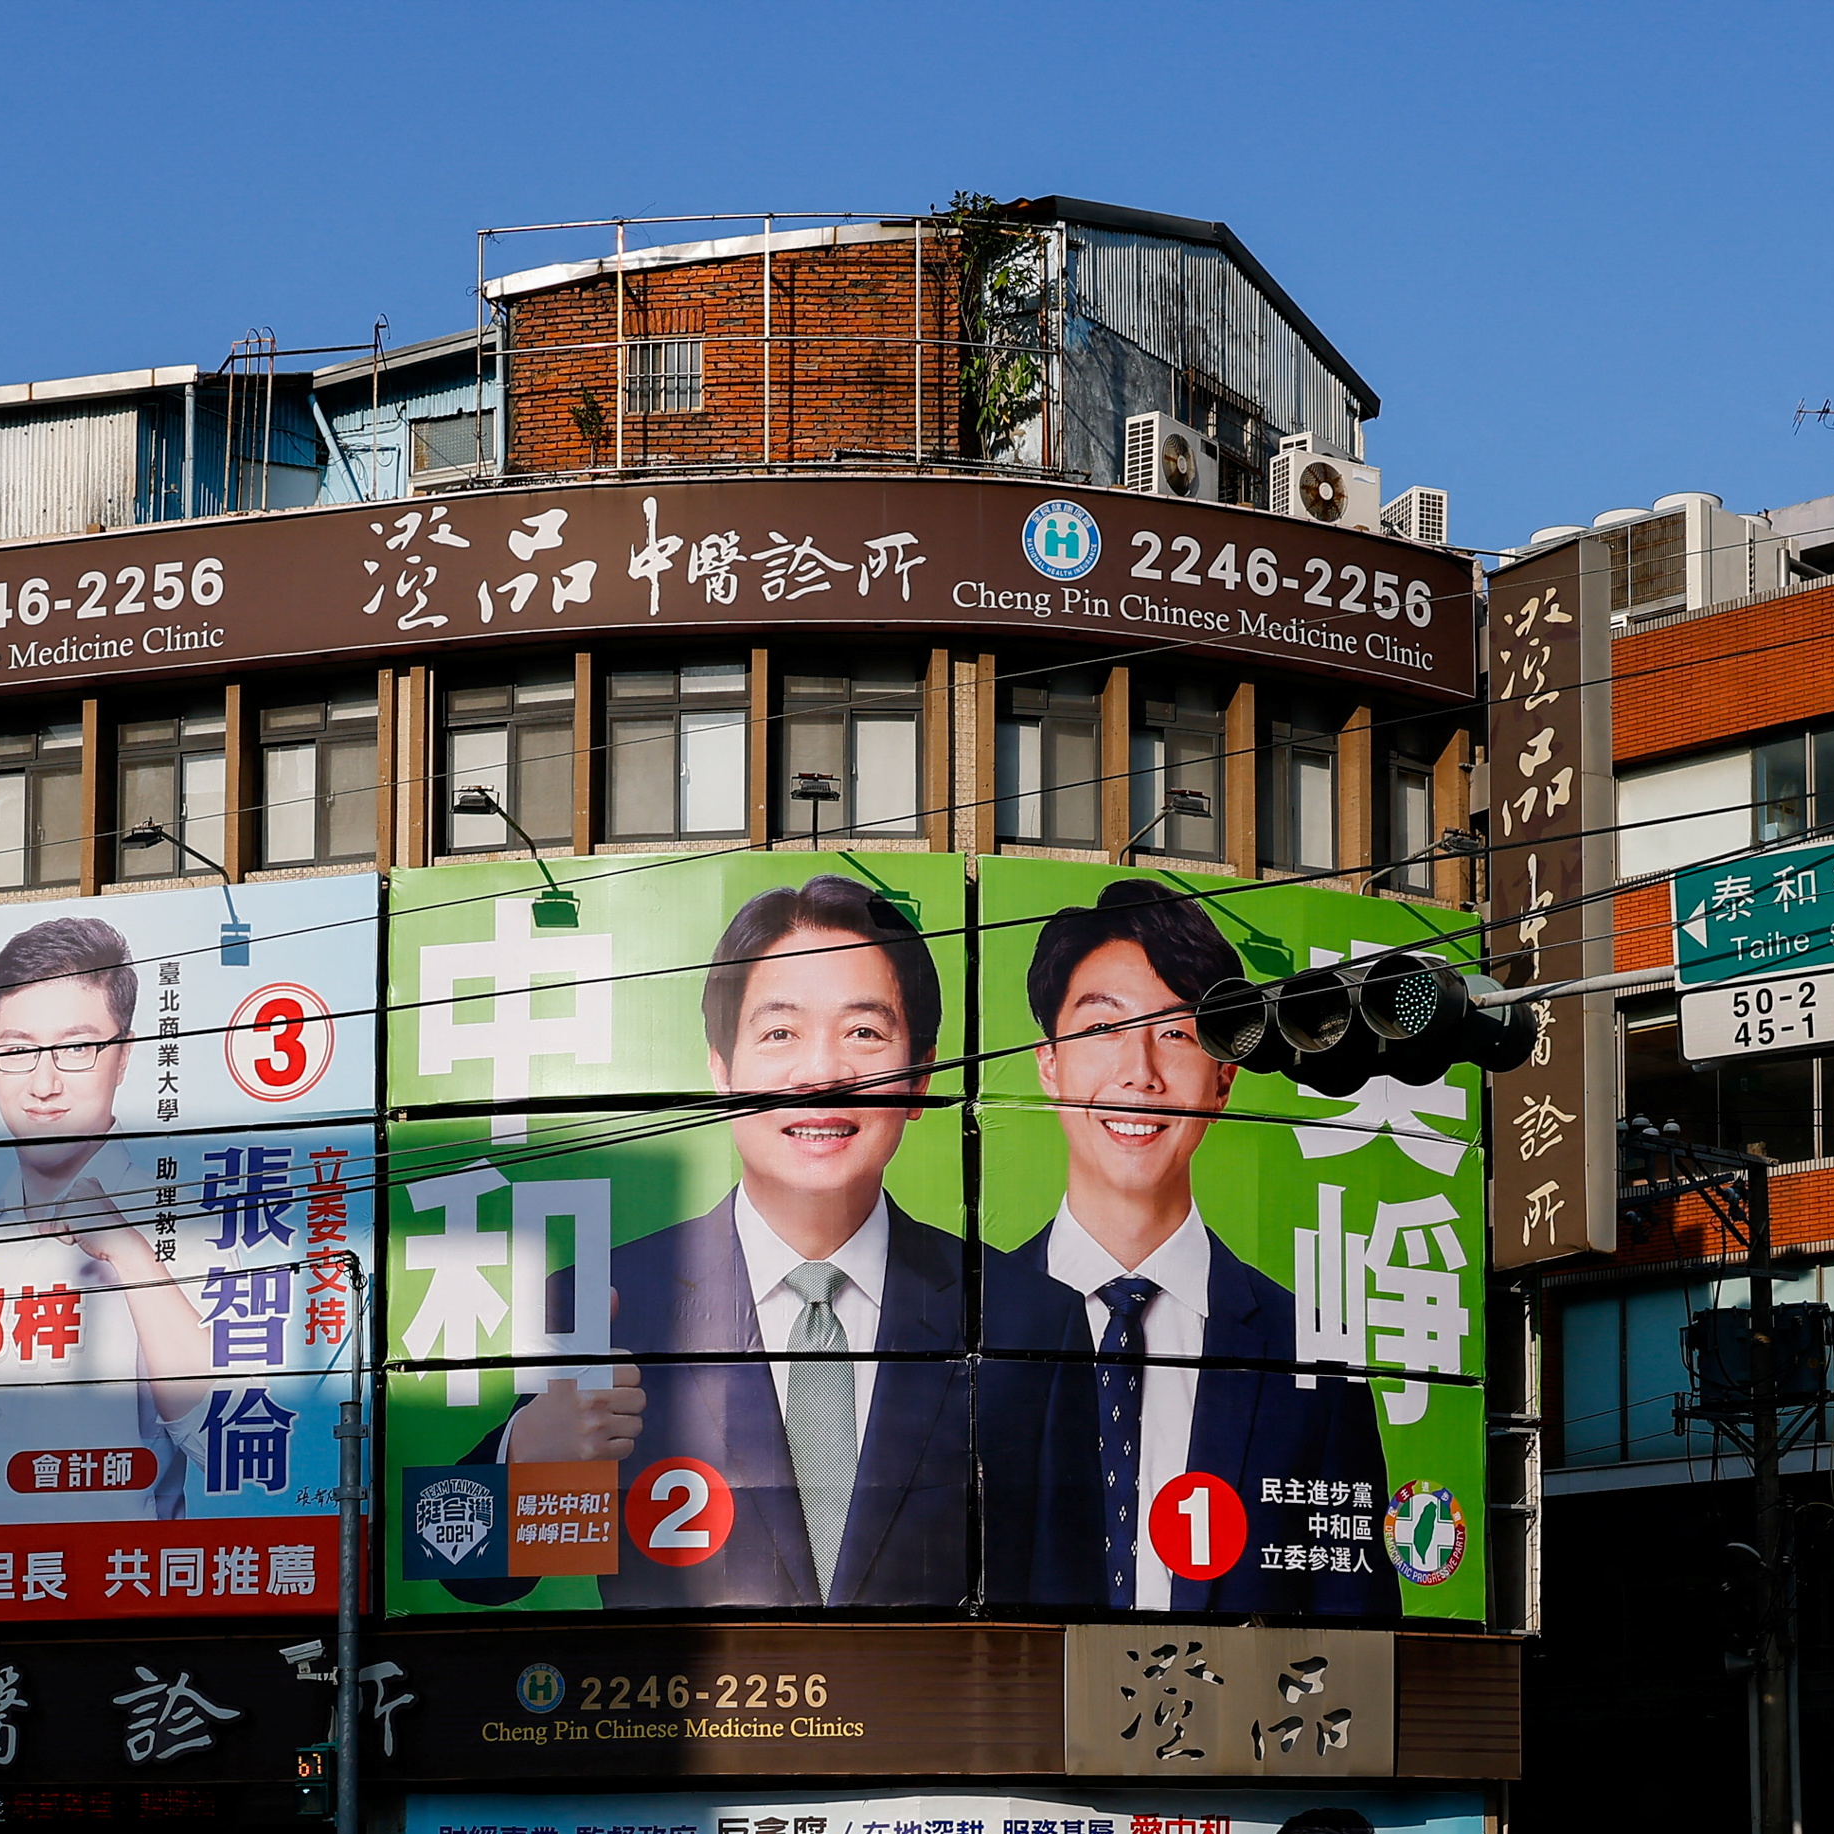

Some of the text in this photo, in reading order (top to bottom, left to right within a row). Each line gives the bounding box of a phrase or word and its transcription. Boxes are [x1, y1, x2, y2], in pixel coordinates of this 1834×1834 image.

[1130, 530, 1433, 628] 2246-2256
[8, 634, 133, 670] Medicine
[142, 622, 224, 654] Clinic
[952, 580, 1434, 673] Cheng Pin Chinese Medicine Clinic
[1730, 933, 1810, 962] Taihe
[1732, 981, 1817, 1018] 50-2
[253, 997, 307, 1087] 3
[1734, 1012, 1817, 1049] 45-1
[154, 961, 181, 1264] 臺北商業大學 助理教授
[403, 896, 614, 1407] 中和
[304, 1145, 350, 1347] 立委支持
[197, 1145, 298, 1497] 張智倫
[30, 1451, 133, 1491] 會計師
[419, 1478, 490, 1500] TEAM TAIWAN
[1260, 1478, 1373, 1508] 民主進步黨
[436, 1524, 474, 1543] 2024
[647, 1470, 711, 1551] 2
[1175, 1489, 1211, 1565] 1
[1308, 1512, 1373, 1540] 中和區
[106, 1543, 317, 1600] 共同推薦
[1260, 1543, 1374, 1574] 立委參選人
[1385, 1525, 1465, 1584] DEMOCRATIC PROGRESSIVE PARTY
[579, 1674, 828, 1712] 2246-2256
[482, 1716, 864, 1745] Cheng Pin Chinese Medicine Clinics
